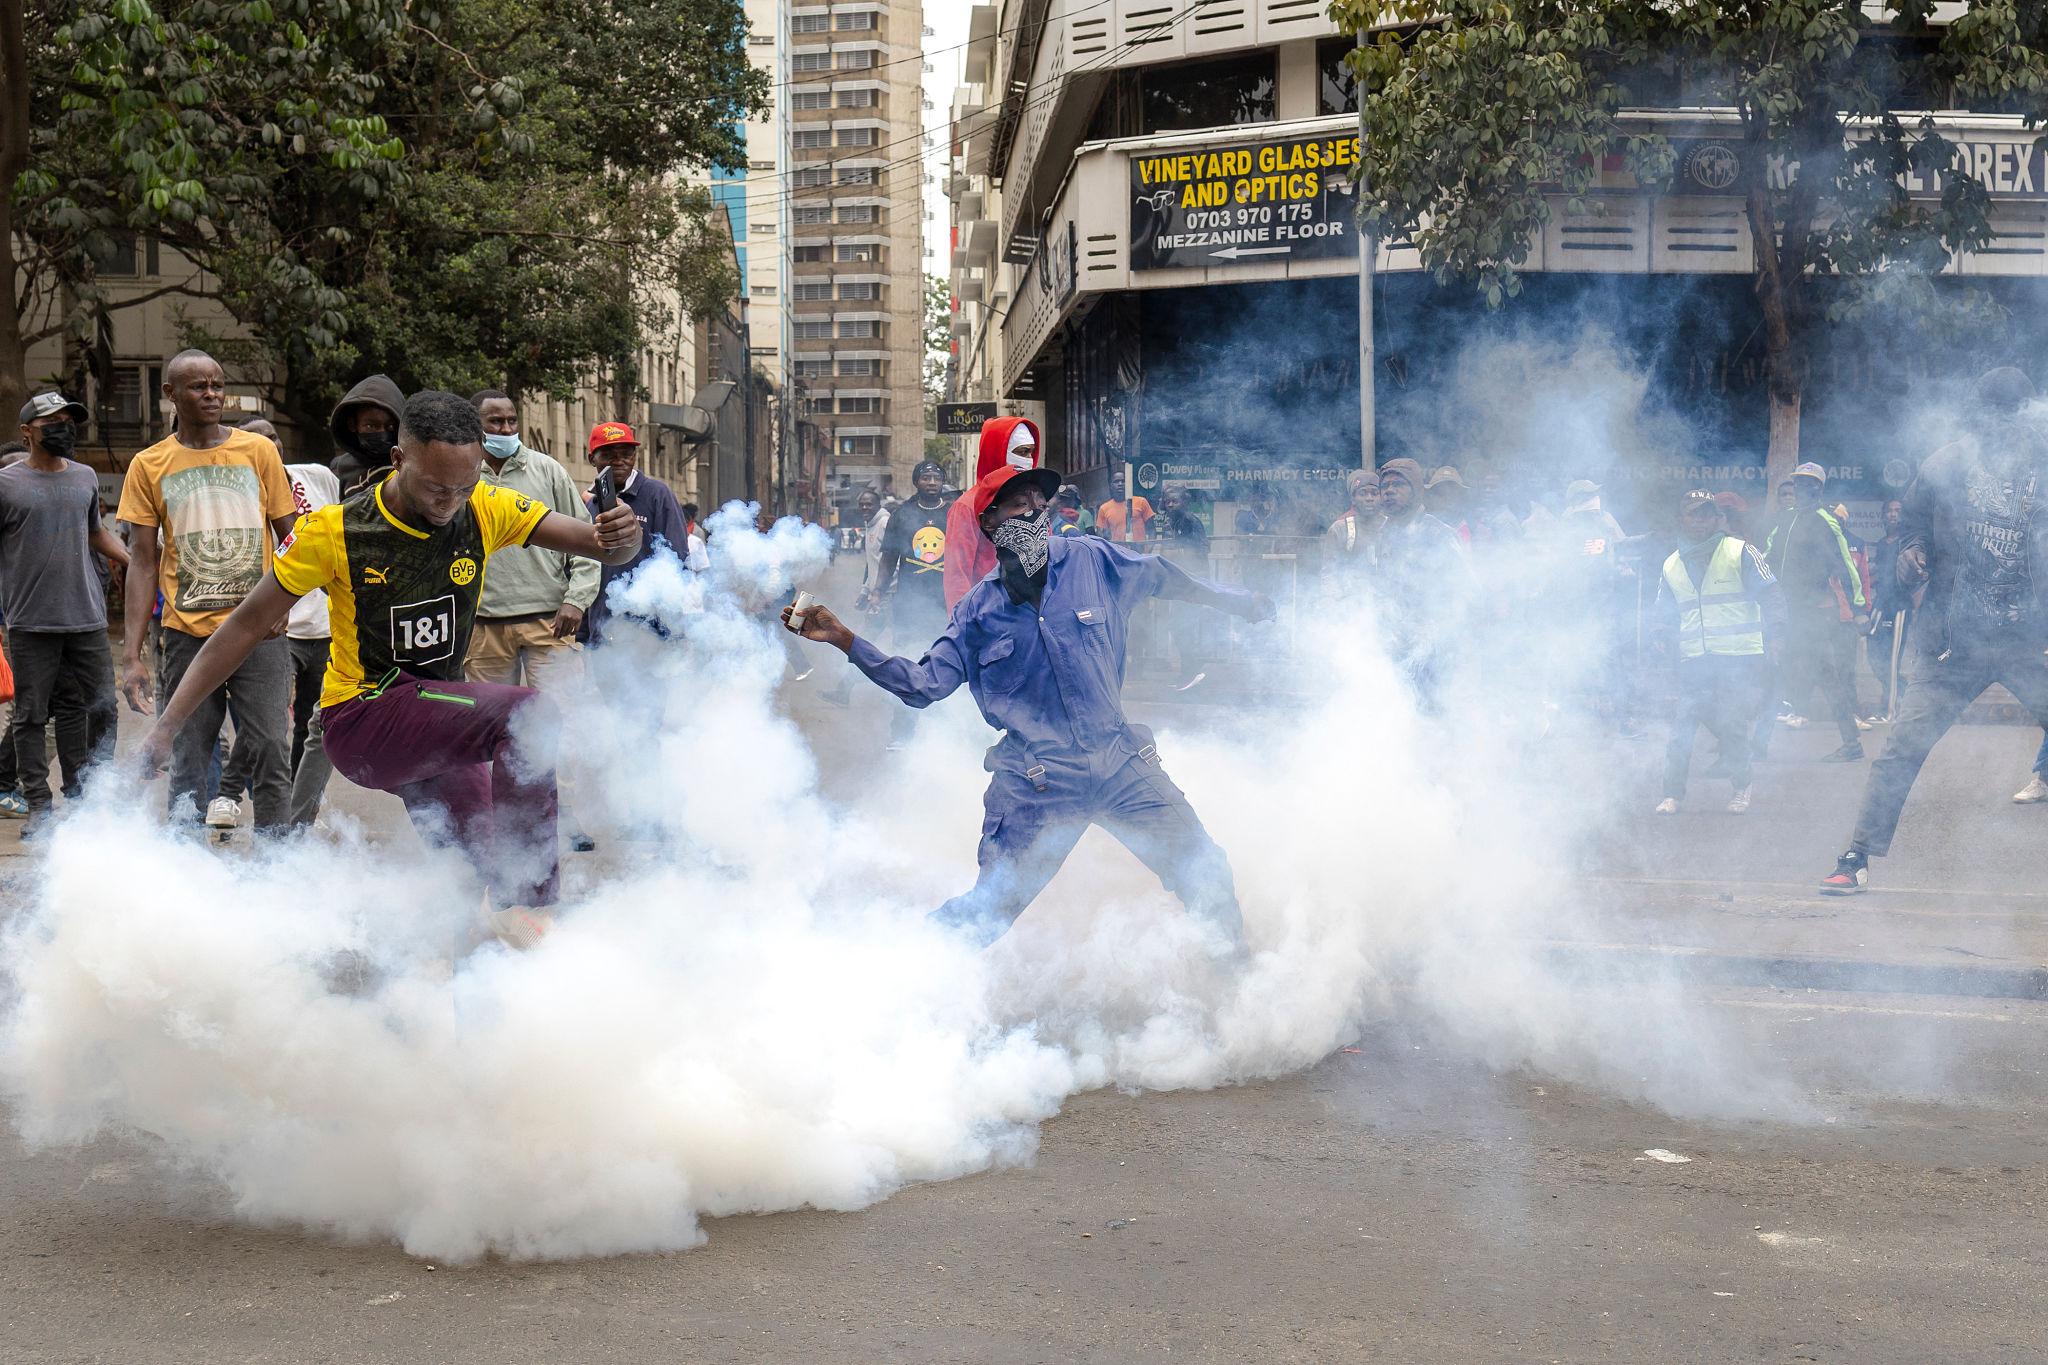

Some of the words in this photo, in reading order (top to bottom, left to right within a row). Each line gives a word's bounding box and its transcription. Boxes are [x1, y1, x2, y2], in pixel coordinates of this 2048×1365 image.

[1139, 150, 1252, 184] VINEYARD
[1259, 138, 1360, 173] GLASSES
[1933, 143, 2034, 192] OREX
[1181, 181, 1228, 209] AND
[1234, 172, 1319, 204] OPTICS
[1186, 210, 1231, 230] 0703
[1237, 206, 1271, 225] 970
[1277, 203, 1312, 222] 175
[1157, 227, 1270, 249] MEZZANINE
[1276, 222, 1343, 240] FLOOR
[948, 413, 985, 427] LIQUOR
[1162, 463, 1193, 477] Dovey
[1227, 469, 1299, 481] PHARMACY
[1303, 468, 1354, 481] EYECAR
[1660, 465, 1767, 480] PHARMACY
[452, 561, 475, 578] BVB
[399, 612, 449, 650] 1&1
